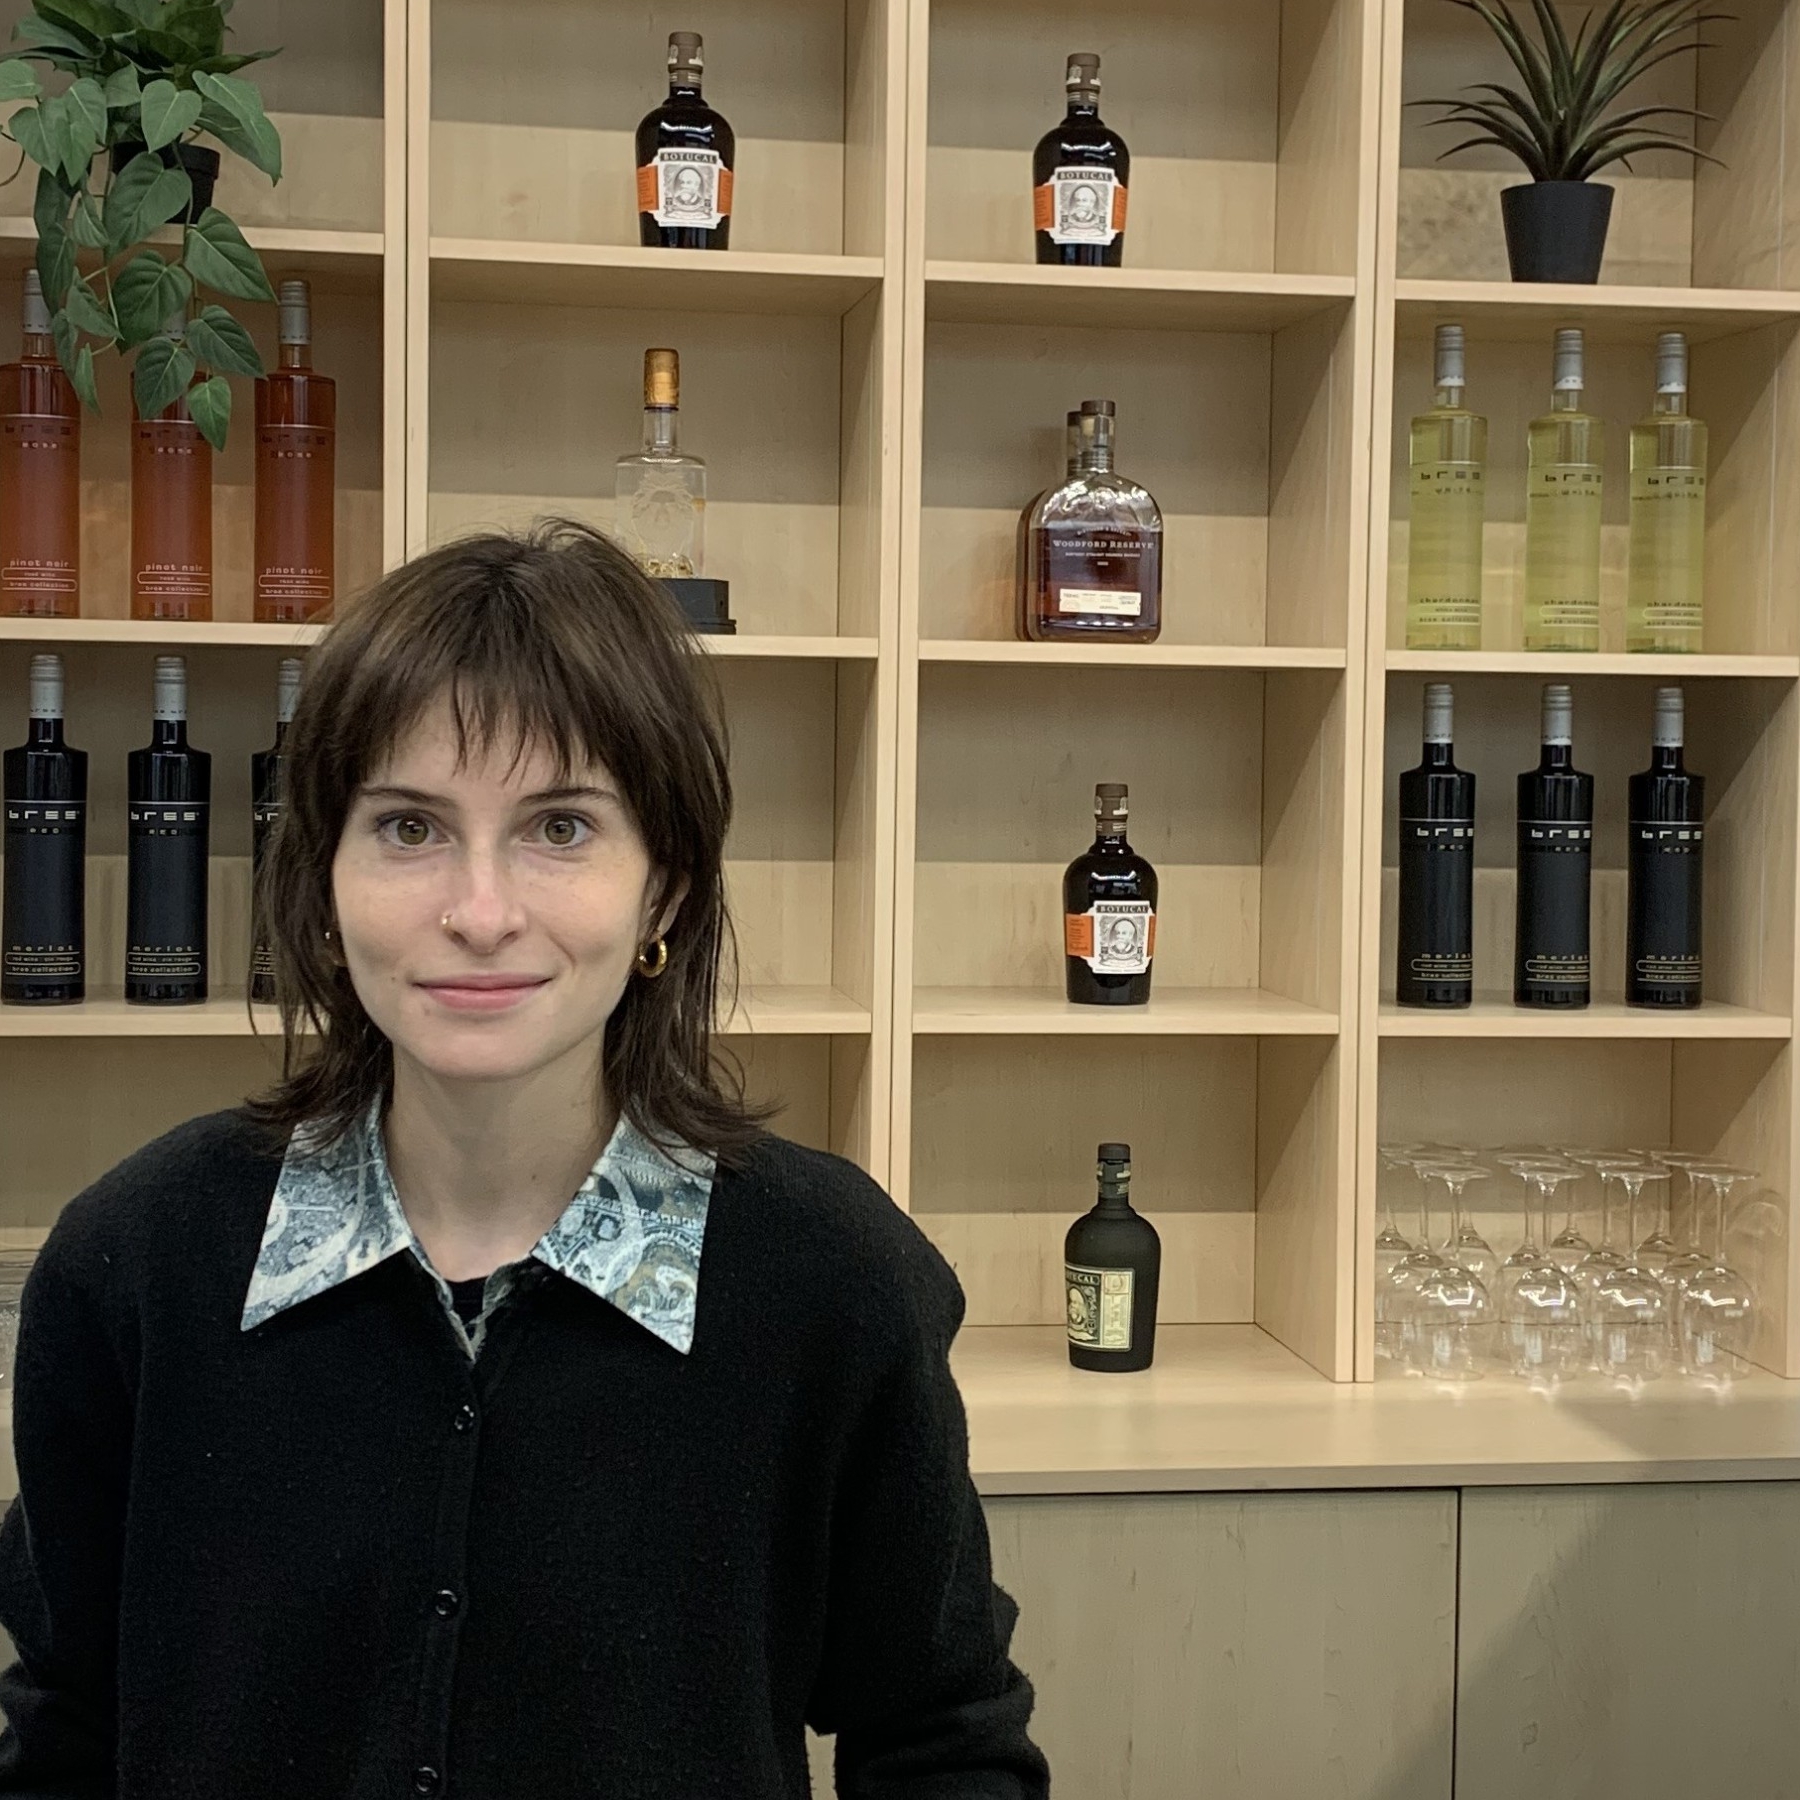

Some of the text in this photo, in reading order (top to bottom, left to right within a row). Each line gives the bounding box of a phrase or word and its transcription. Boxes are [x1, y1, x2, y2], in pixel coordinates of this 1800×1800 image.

[663, 153, 714, 163] BOTUCAL
[1060, 172, 1109, 181] BOTUCAL
[9, 560, 41, 569] pinot
[145, 562, 203, 572] pinot noir
[265, 566, 323, 575] pinot noir
[9, 810, 77, 820] bree
[131, 811, 196, 821] bree
[1417, 827, 1474, 837] bree
[1531, 829, 1591, 839] bree
[1641, 830, 1702, 840] bree
[1100, 905, 1147, 913] BOTUCAL
